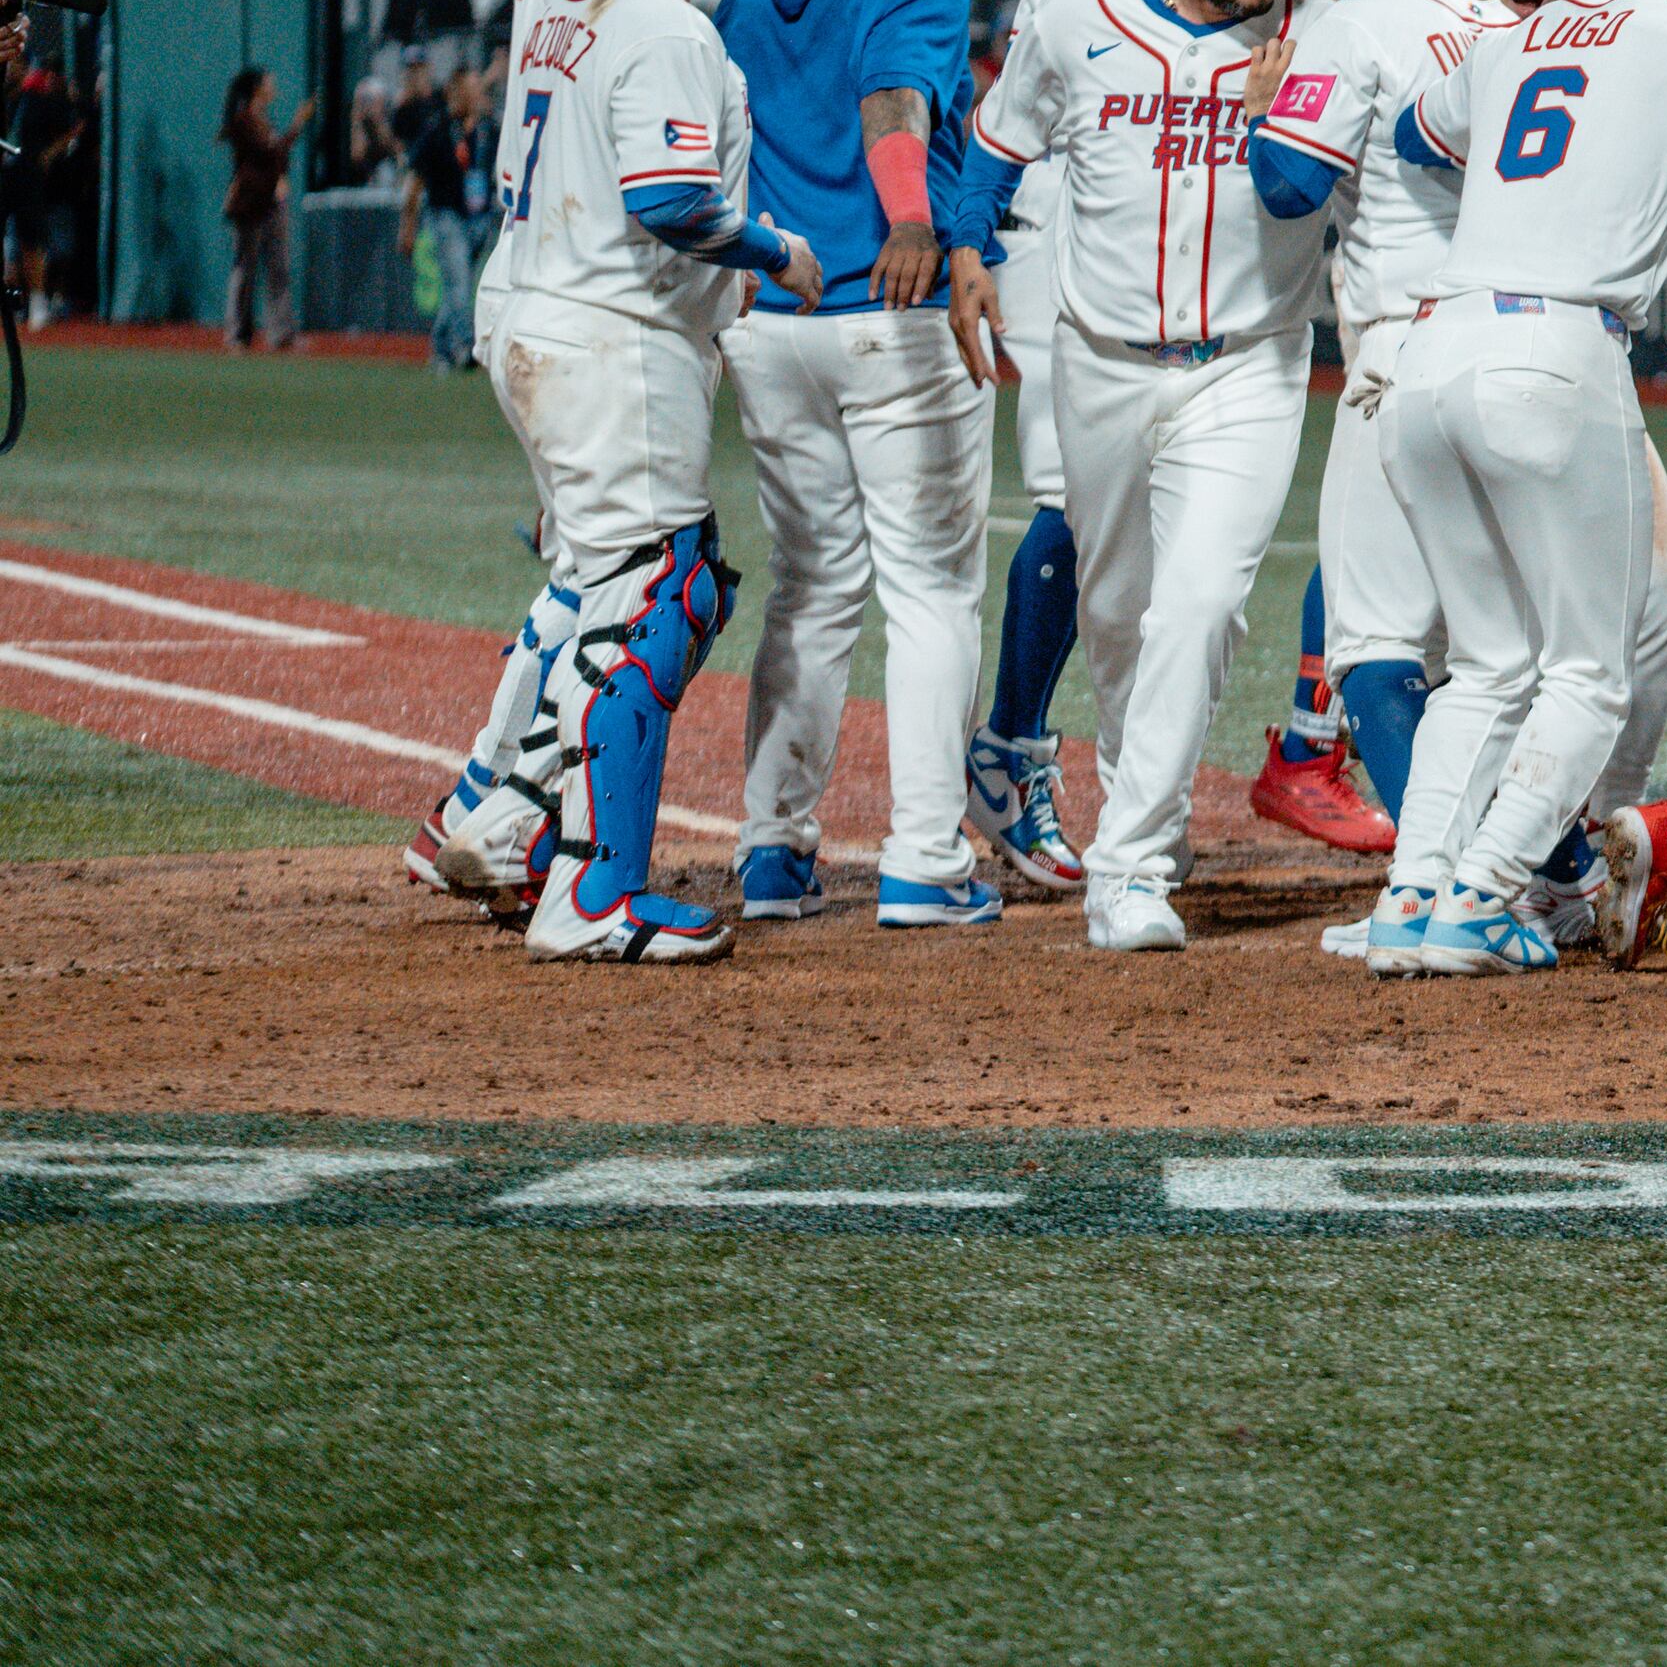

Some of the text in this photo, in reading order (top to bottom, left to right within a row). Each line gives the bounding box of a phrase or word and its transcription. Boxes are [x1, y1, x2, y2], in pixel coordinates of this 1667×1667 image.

[1522, 9, 1635, 53] LUGO
[1098, 93, 1250, 132] PUERT
[1494, 65, 1589, 183] 6
[513, 88, 553, 222] 7
